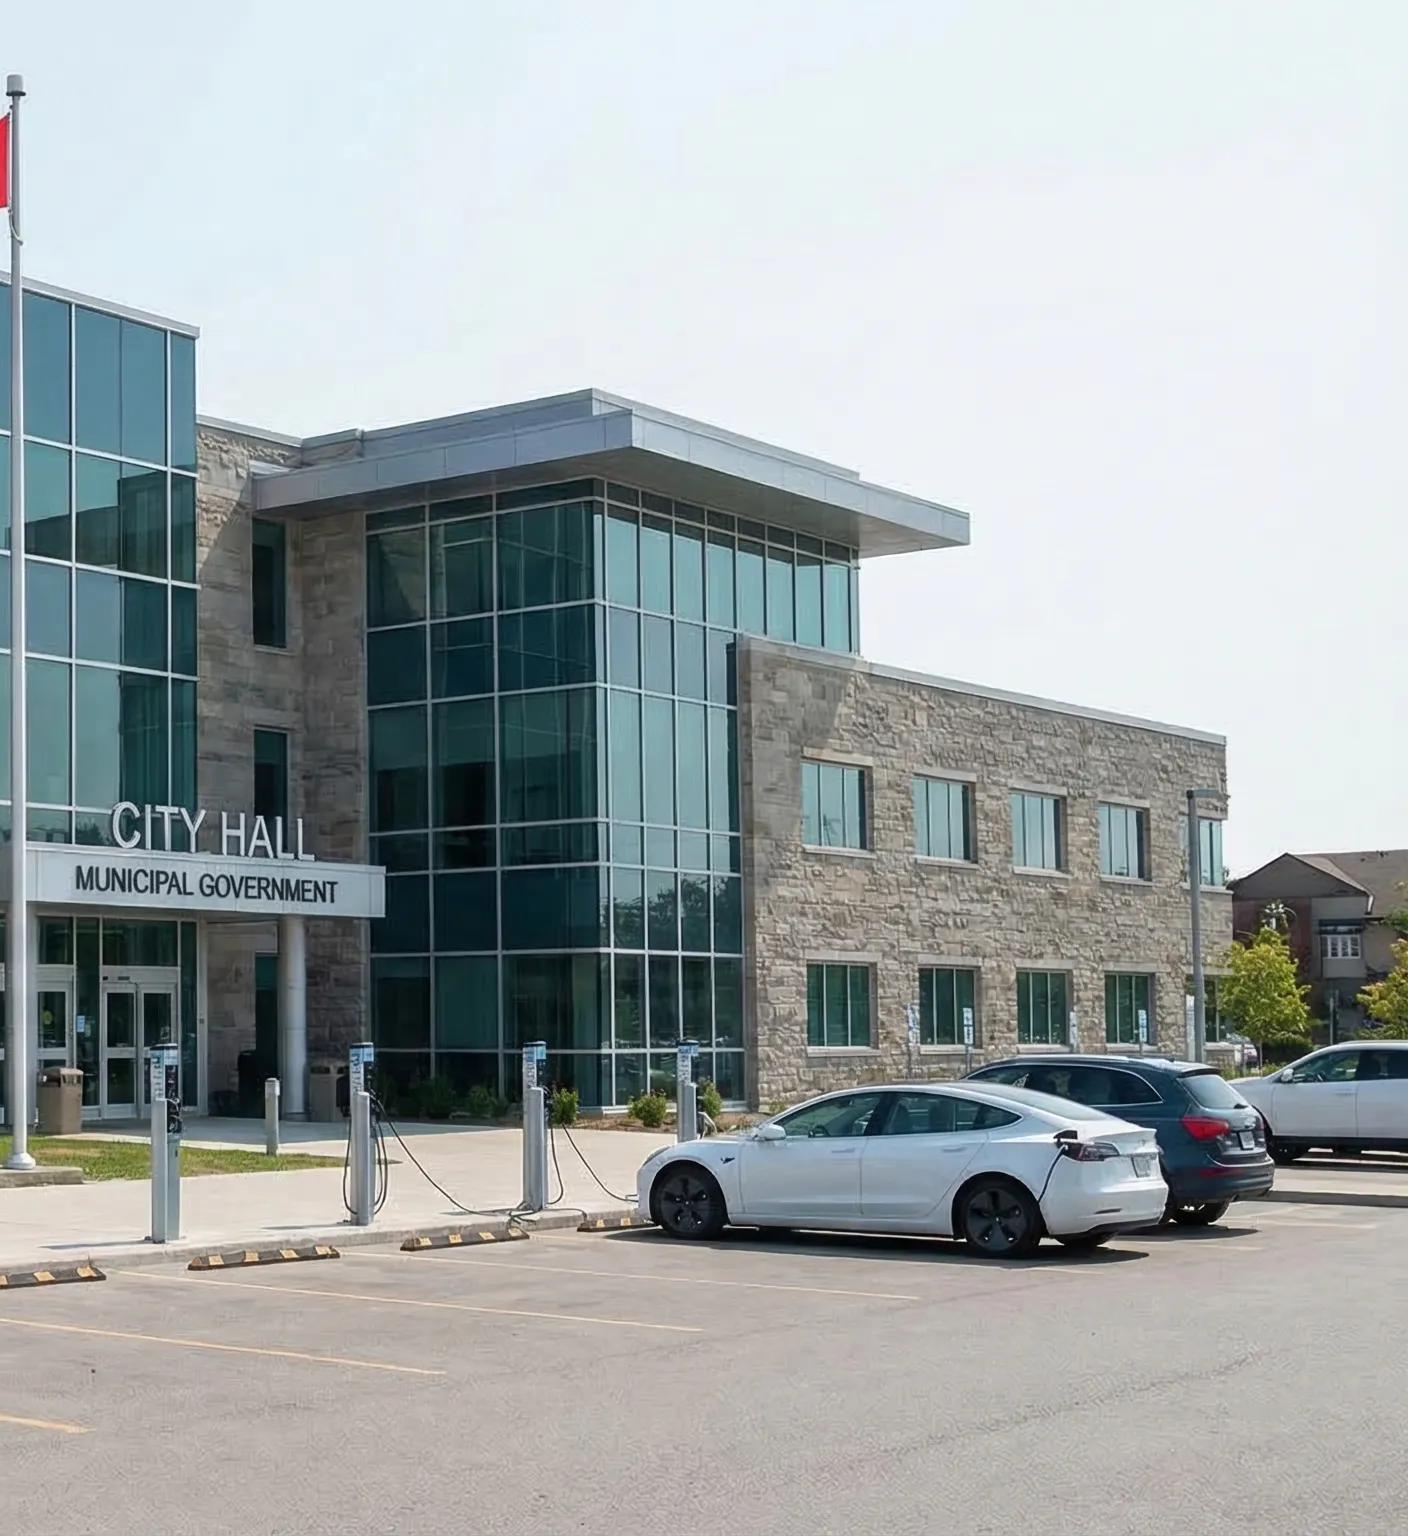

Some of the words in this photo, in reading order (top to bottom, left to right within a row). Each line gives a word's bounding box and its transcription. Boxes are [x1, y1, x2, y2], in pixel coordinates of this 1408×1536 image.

[112, 801, 206, 853] CITY
[222, 811, 315, 862] HALL
[75, 865, 195, 896] MUNICIPAL
[198, 873, 339, 904] GOVERNMENT
